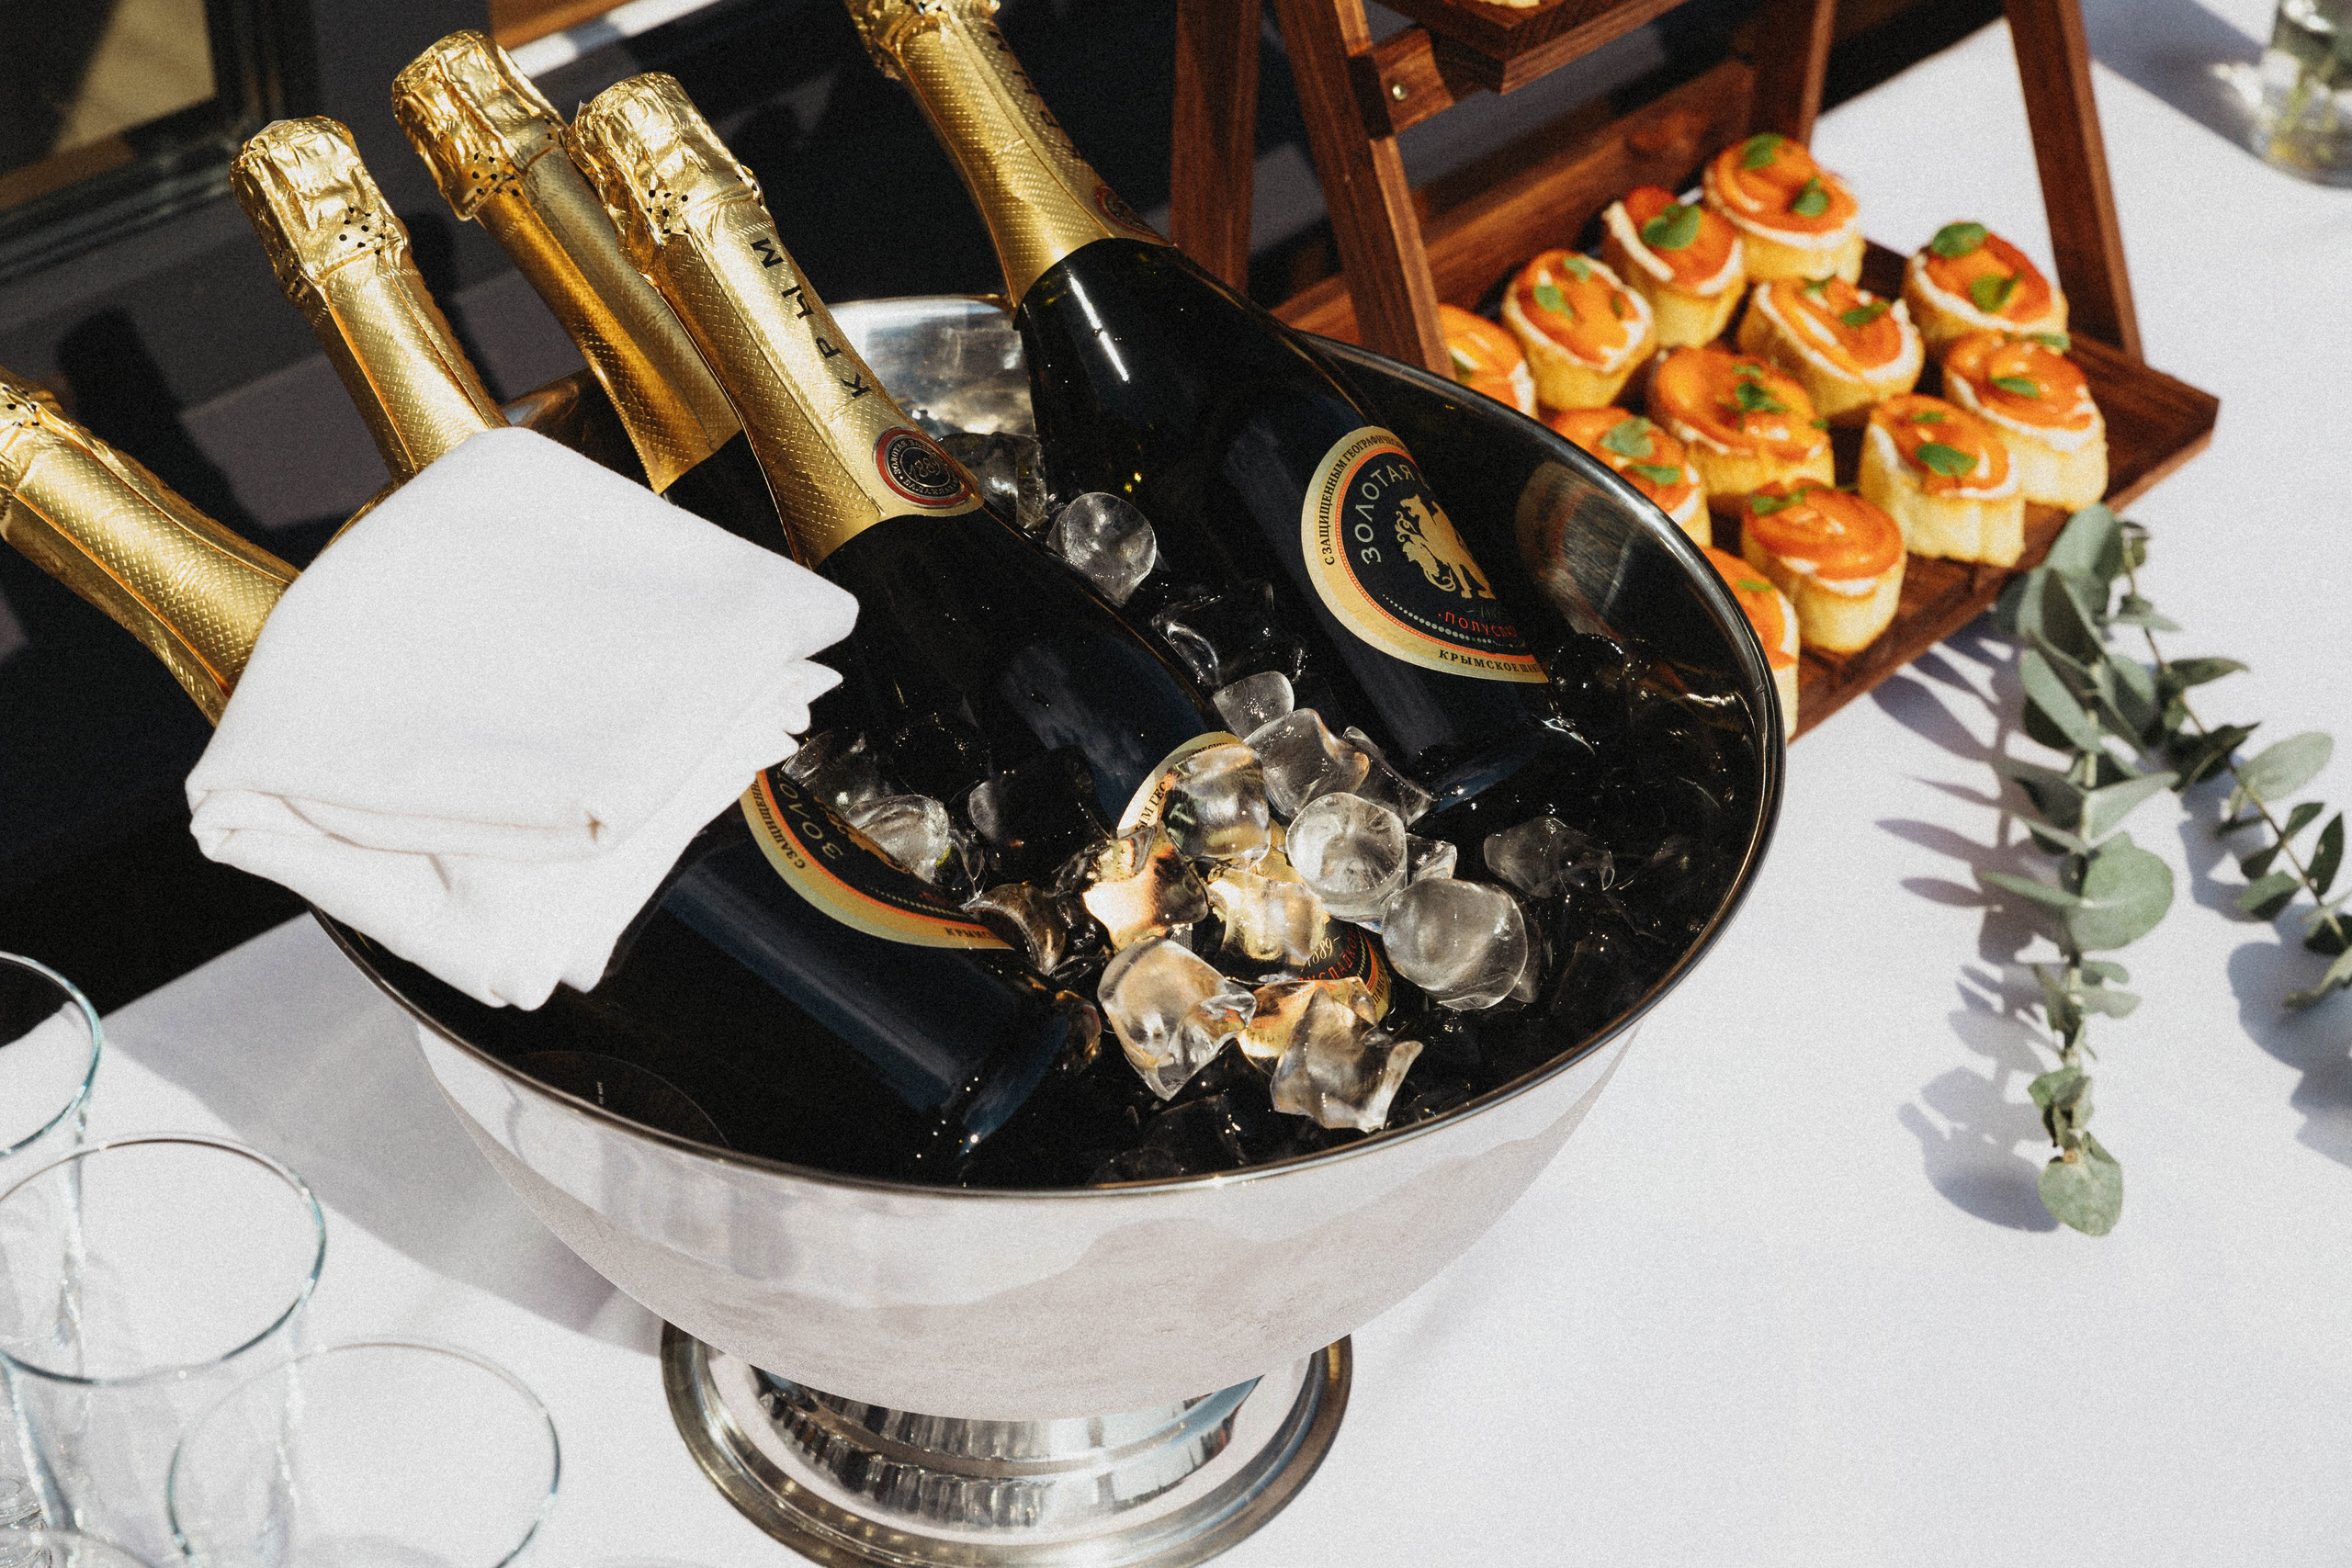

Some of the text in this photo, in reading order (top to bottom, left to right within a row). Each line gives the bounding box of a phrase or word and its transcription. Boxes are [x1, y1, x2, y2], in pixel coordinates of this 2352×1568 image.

[750, 237, 872, 399] КРЫМ
[1318, 459, 1346, 555] ЗАЩИЩЕННЫМ
[1354, 464, 1416, 565] ЗОЛОТАЯ
[1324, 556, 1335, 566] С
[1439, 649, 1520, 672] КРЫМСКОЕ
[794, 858, 806, 870] С
